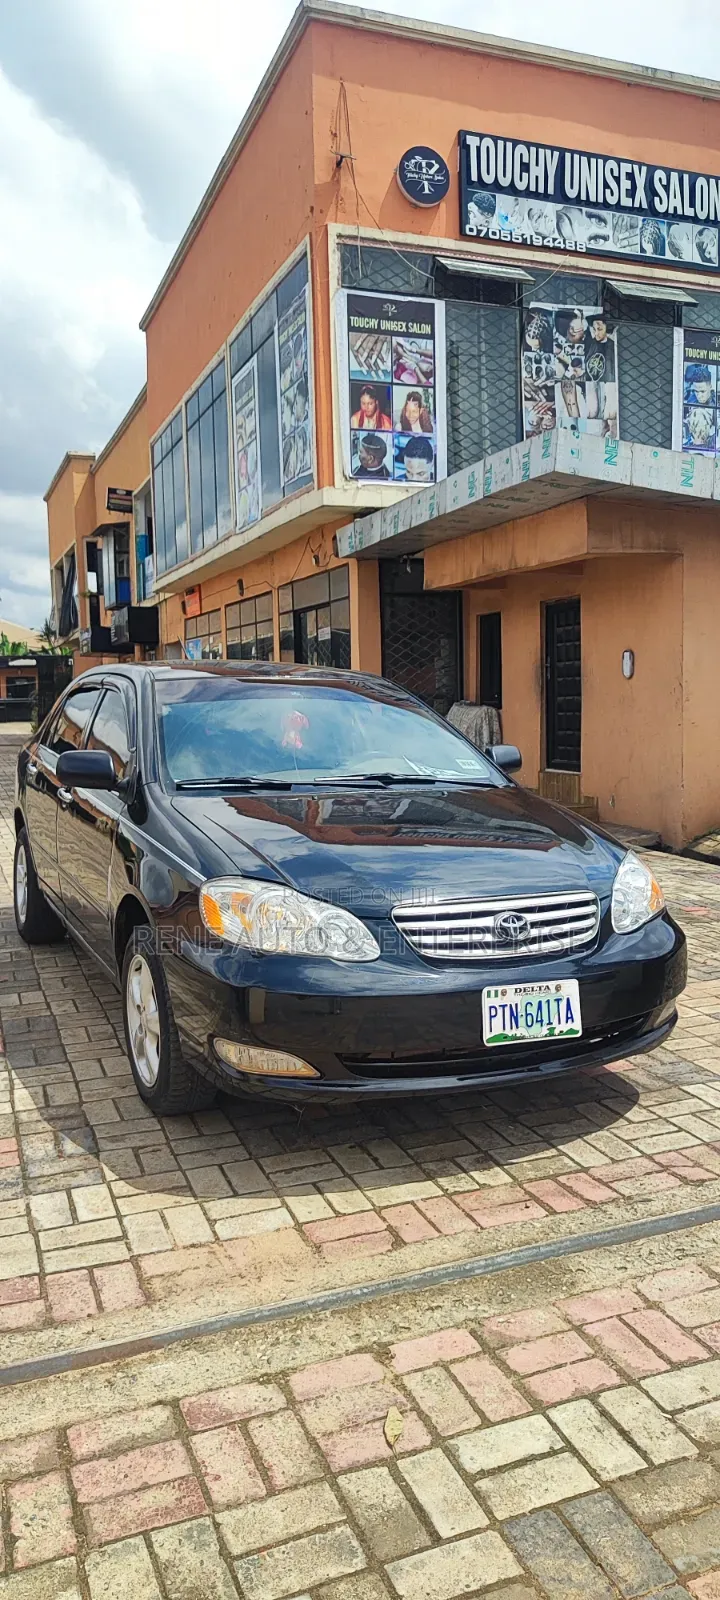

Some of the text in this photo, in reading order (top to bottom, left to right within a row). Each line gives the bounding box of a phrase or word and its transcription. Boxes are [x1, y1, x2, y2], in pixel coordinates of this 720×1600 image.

[466, 135, 720, 222] TOUCHY UNISEX SALON
[465, 225, 587, 253] 07055194488
[350, 315, 431, 335] TOUCHY UNISEX SALON
[685, 347, 720, 361] TOUCHY UNI
[514, 984, 551, 994] DELTA
